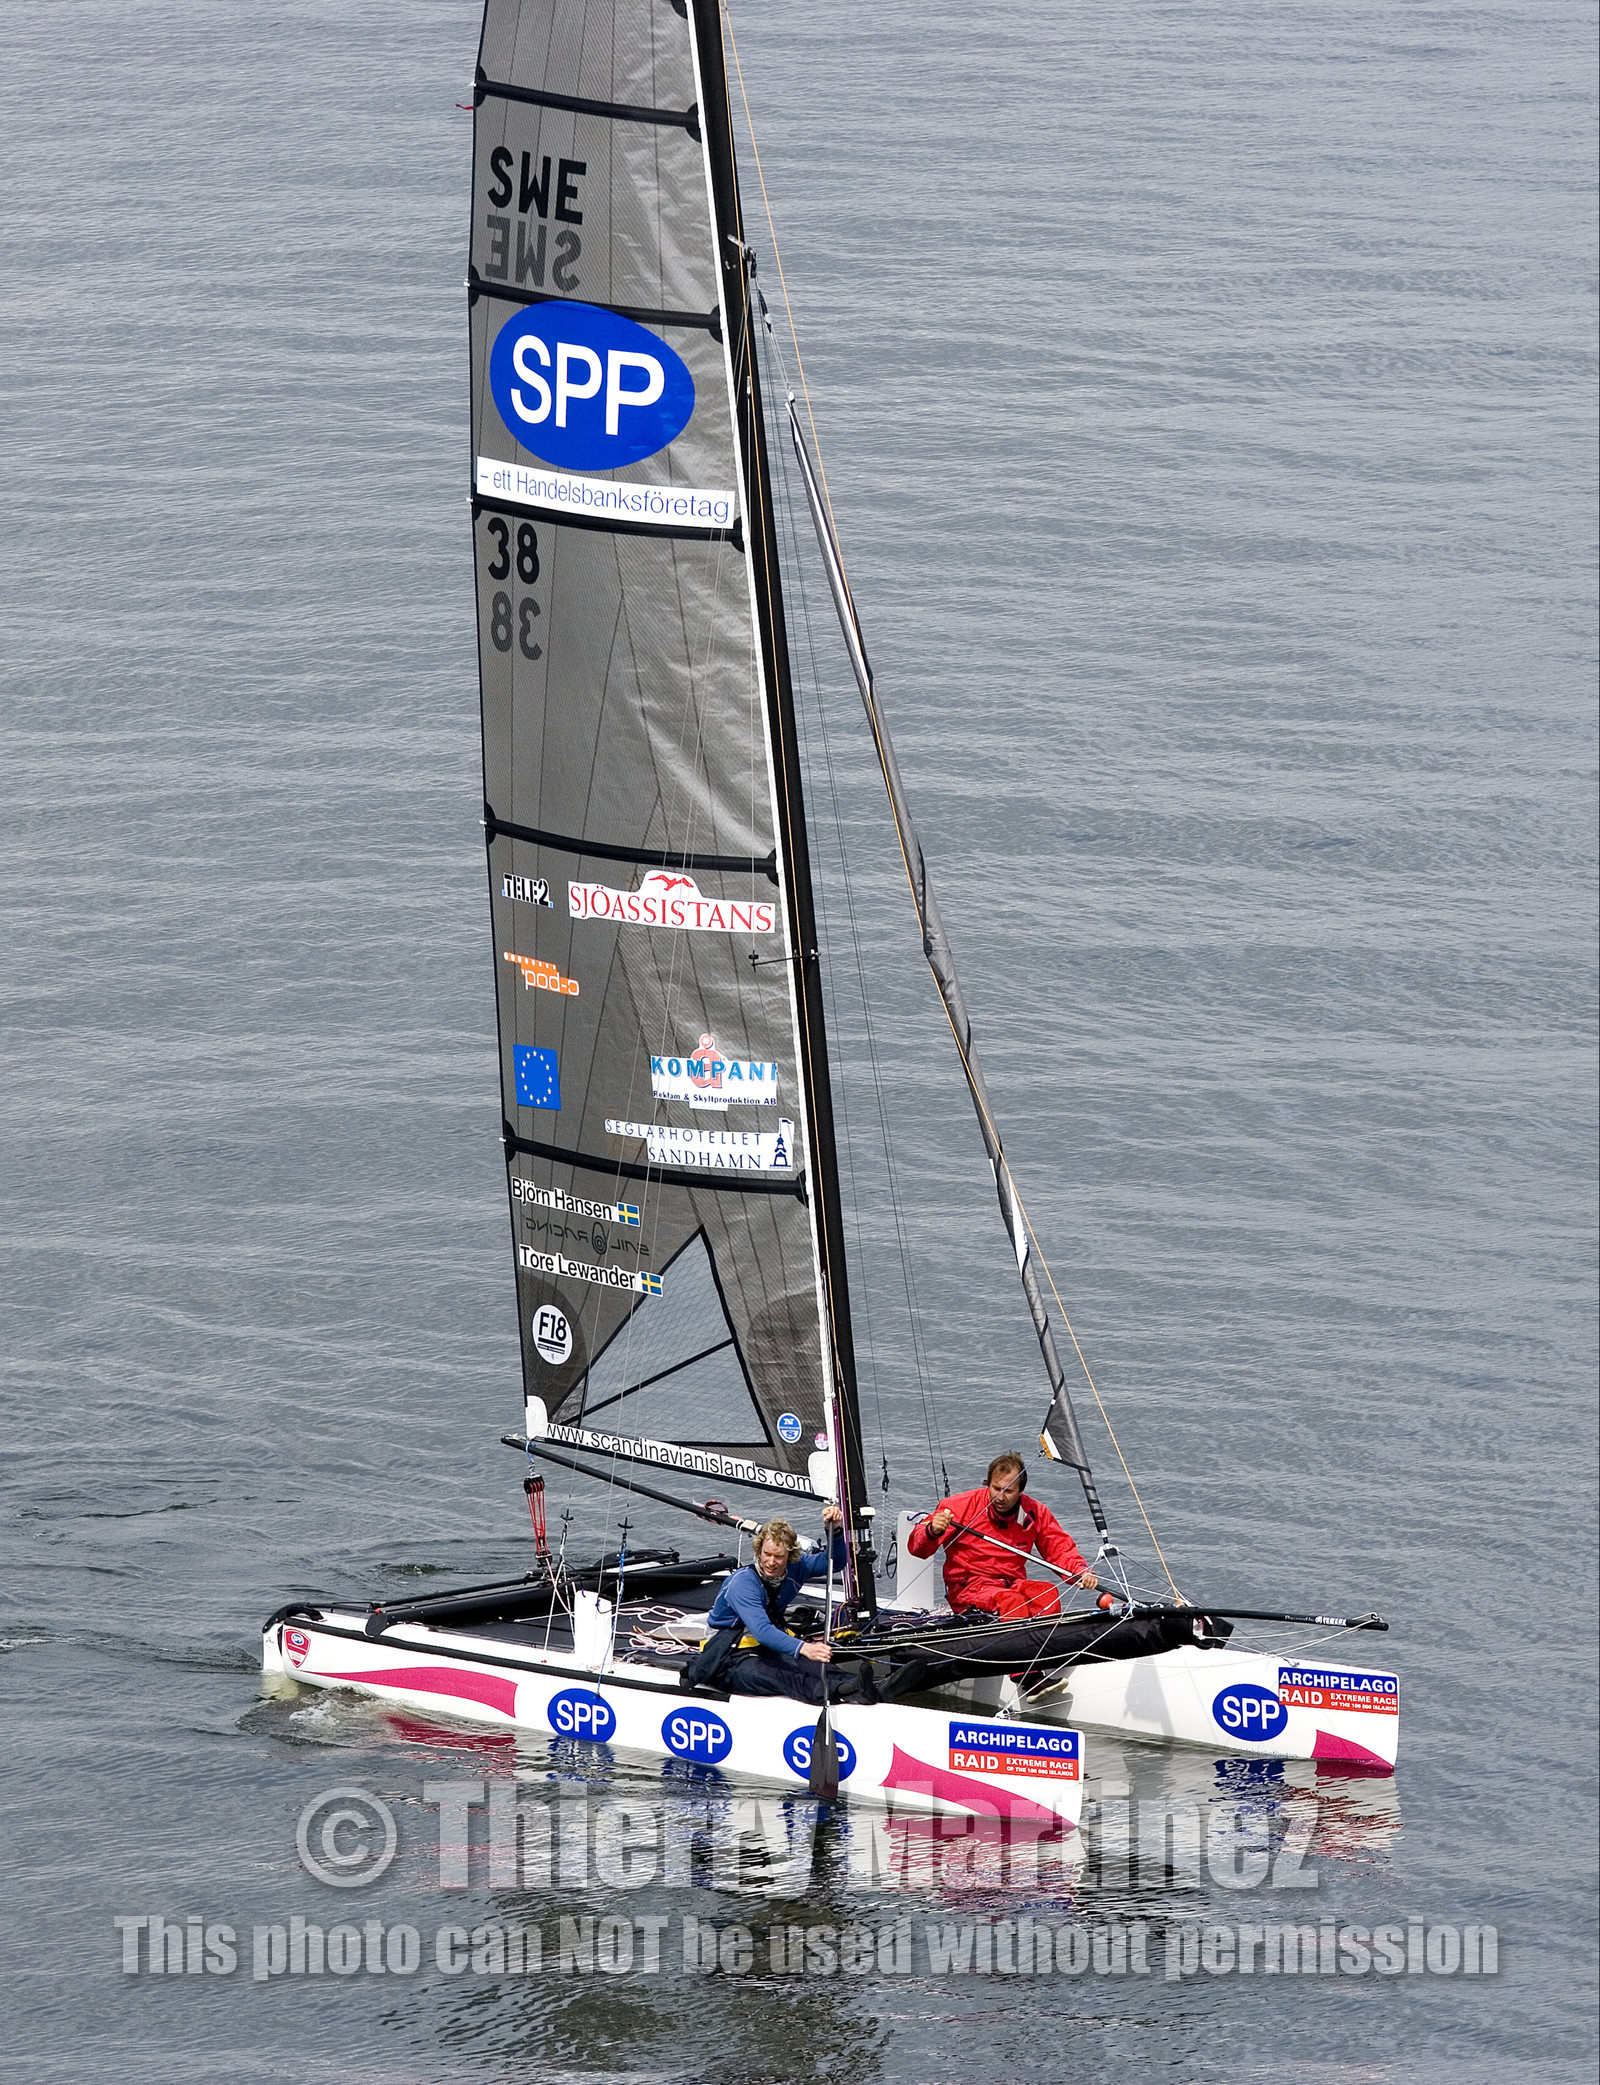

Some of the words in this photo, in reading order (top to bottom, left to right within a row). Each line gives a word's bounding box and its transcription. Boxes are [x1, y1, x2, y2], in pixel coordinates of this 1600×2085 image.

[487, 146, 587, 225] SWE
[510, 334, 665, 436] SPP
[493, 468, 511, 491] ett
[517, 471, 729, 523] Handelsbanksföretag
[487, 517, 540, 585] 38
[503, 873, 550, 908] TELE2
[570, 885, 772, 932] SJÖASSISTANS
[651, 1056, 777, 1081] KOMPANI
[653, 1090, 681, 1101] Reklam
[693, 1094, 760, 1105] Skyltproduktion
[604, 1119, 761, 1146] SEGLARHOTELLET
[648, 1146, 761, 1169] SANDHAMN
[512, 1178, 550, 1205] Björn
[554, 1188, 613, 1220] Hansen
[520, 1246, 554, 1272] Tore
[558, 1254, 636, 1289] Lewander
[539, 1311, 567, 1341] F18
[547, 1424, 812, 1492] www.scandinavianislands.com
[1279, 1671, 1396, 1693] ARCHIPELAGO
[1279, 1688, 1323, 1705] RAID
[1330, 1693, 1371, 1703] EXTREME
[1373, 1697, 1397, 1705] RACE
[556, 1699, 609, 1735] SPP
[1222, 1697, 1280, 1730] SPP
[670, 1717, 725, 1754] SPP
[954, 1730, 1073, 1752] ARCHIPELAGO
[953, 1753, 999, 1770] RAID
[1006, 1757, 1047, 1768] EXTREME
[1050, 1761, 1074, 1770] RACE
